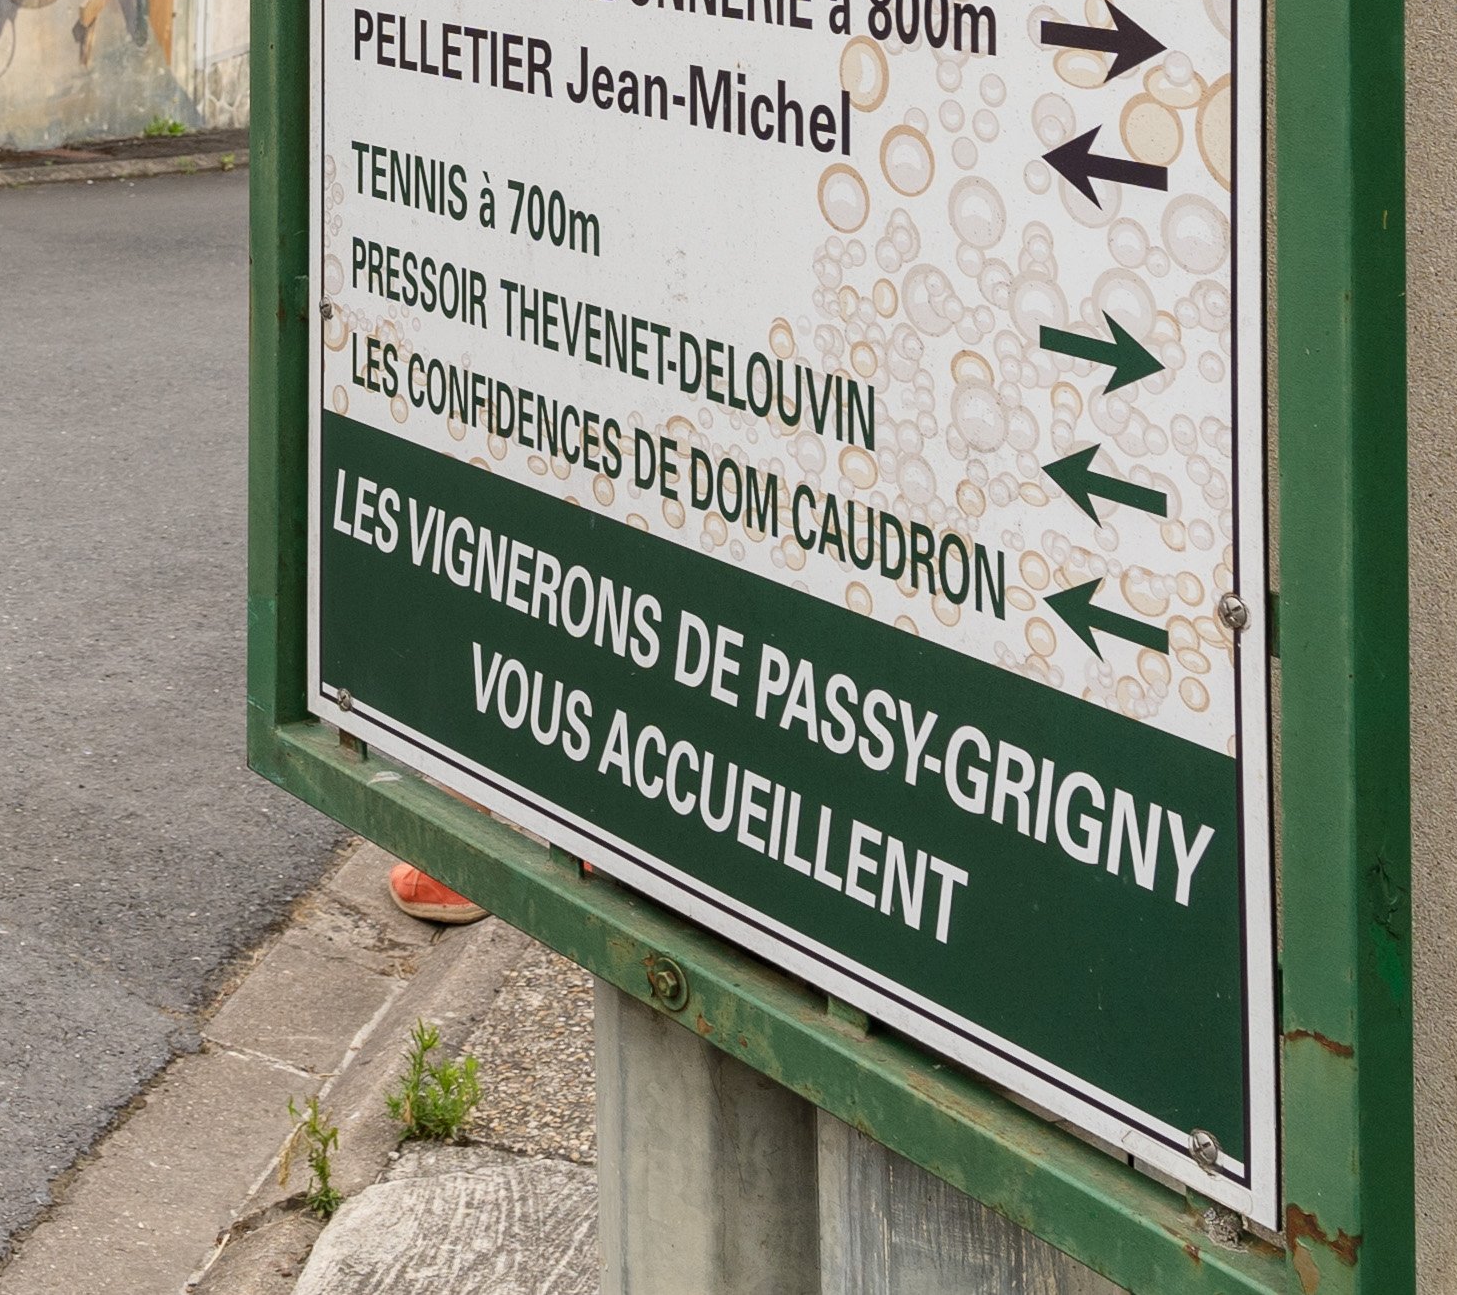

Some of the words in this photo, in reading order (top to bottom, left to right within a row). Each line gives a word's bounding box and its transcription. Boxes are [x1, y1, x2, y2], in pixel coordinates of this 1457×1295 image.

[352, 141, 467, 220] TENNIS
[480, 171, 495, 229] à
[508, 180, 599, 256] 700m
[355, 9, 552, 97] PELLETIER
[567, 47, 850, 155] Jean-Michel
[353, 237, 487, 329] PRESSOIR
[501, 279, 875, 451] THEVENET-DELOUVIN
[353, 332, 398, 398] LES
[408, 353, 622, 479] CONFIDENCES
[635, 428, 678, 501] DE
[691, 447, 778, 537] DOM
[792, 484, 1005, 620] CAUDRON
[334, 469, 400, 553] LES
[409, 498, 661, 668] VIGNERONS
[675, 610, 743, 707] DE
[756, 644, 1215, 906] PASSY-GRIGNY
[473, 642, 592, 761] VOUS
[598, 709, 968, 943] ACCUEILLENT
